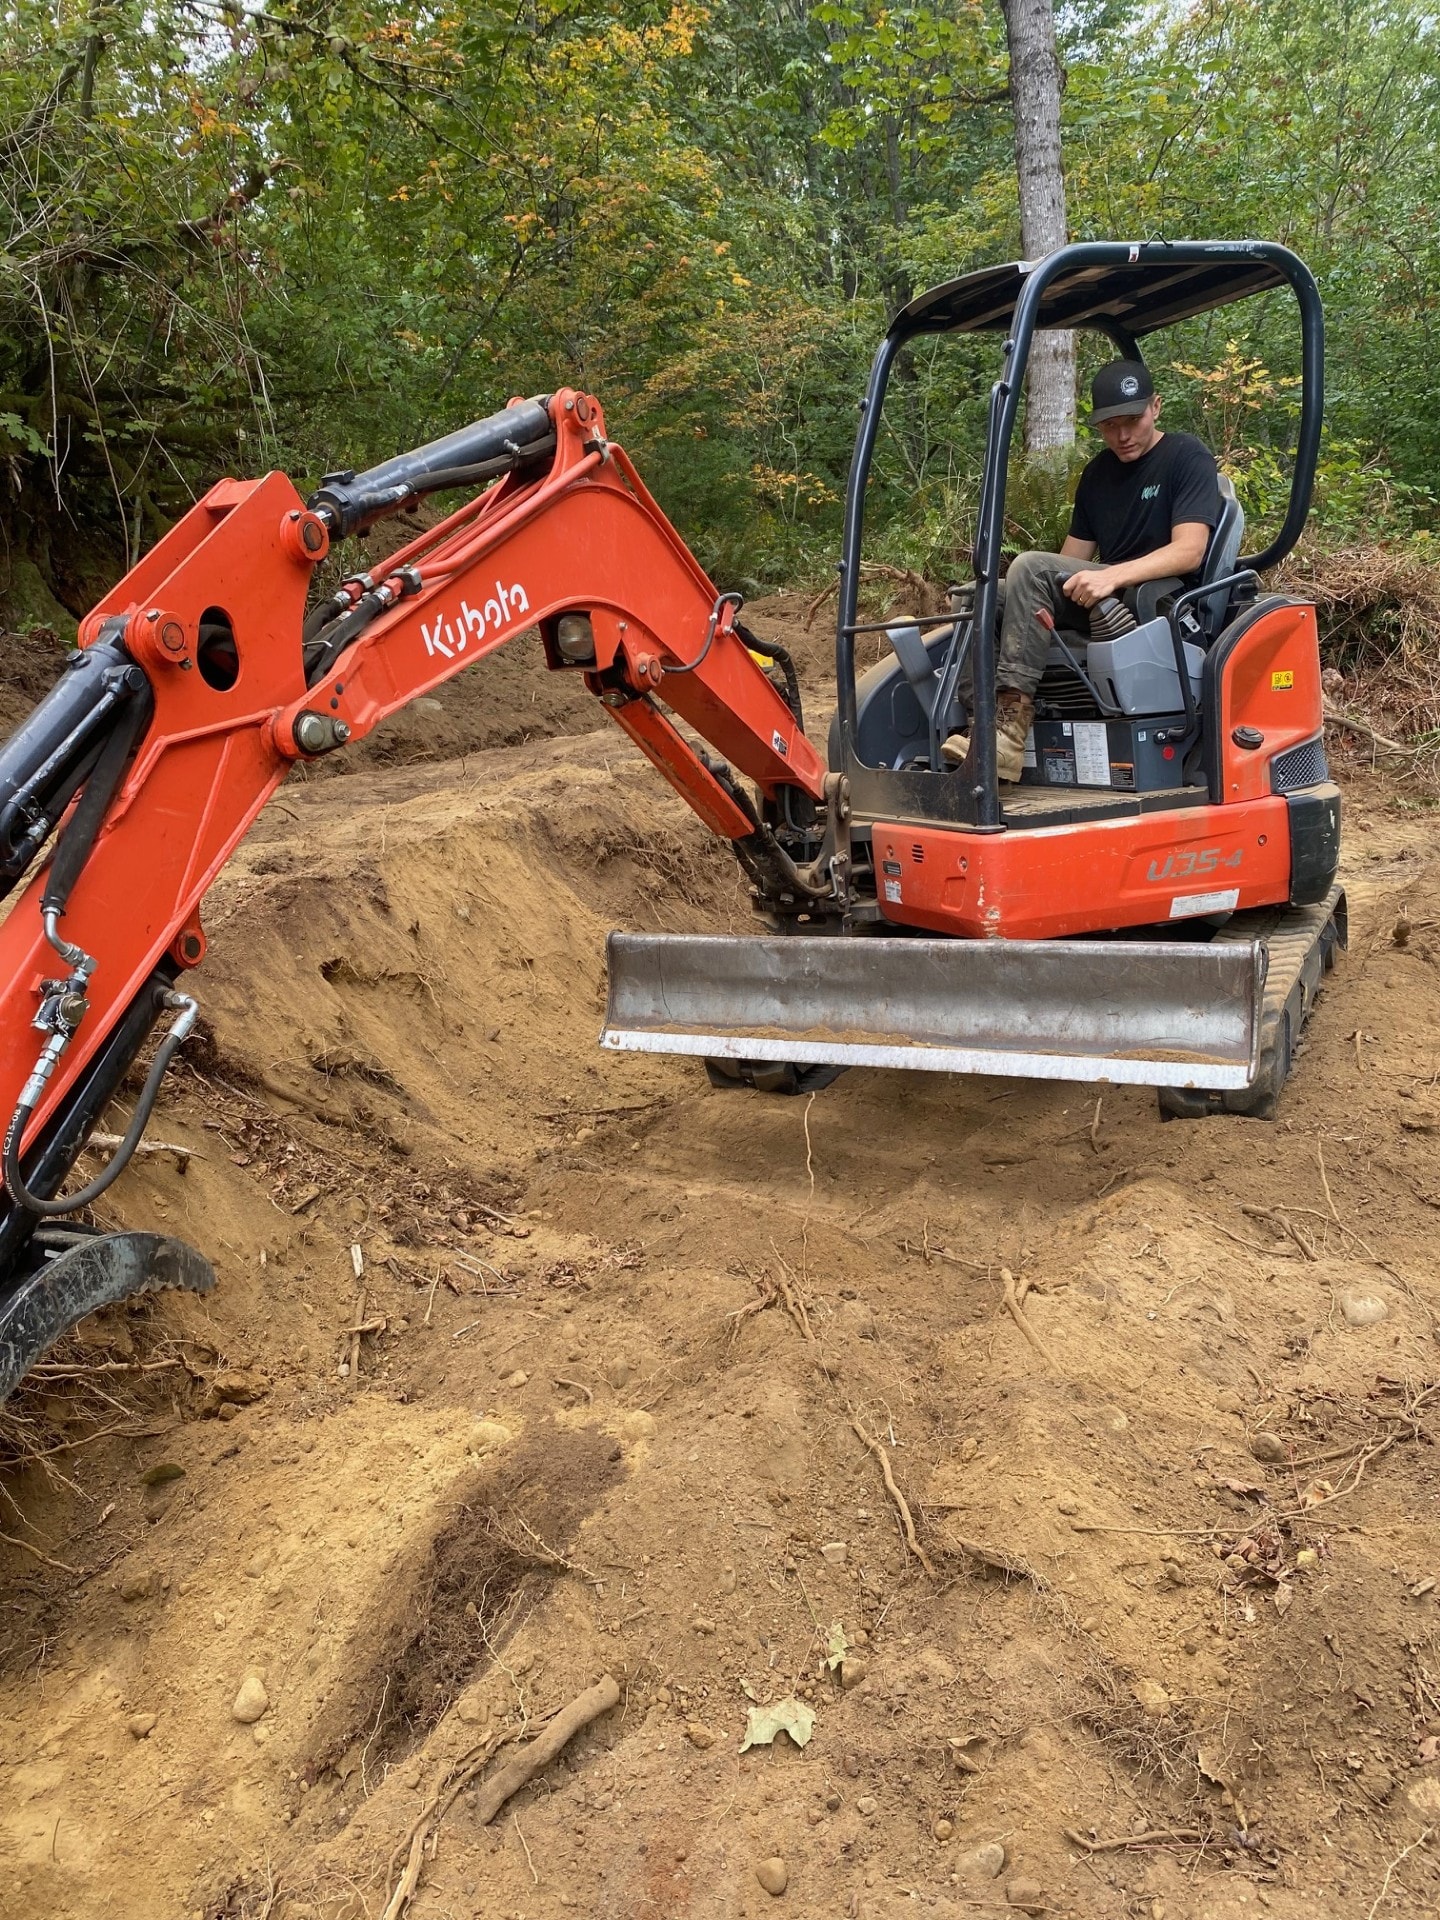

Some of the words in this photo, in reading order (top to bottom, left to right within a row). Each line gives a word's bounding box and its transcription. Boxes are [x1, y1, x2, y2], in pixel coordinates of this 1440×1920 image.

[420, 580, 530, 659] Kubota
[1146, 848, 1244, 882] U35-4
[2, 1108, 22, 1156] EC215-08
